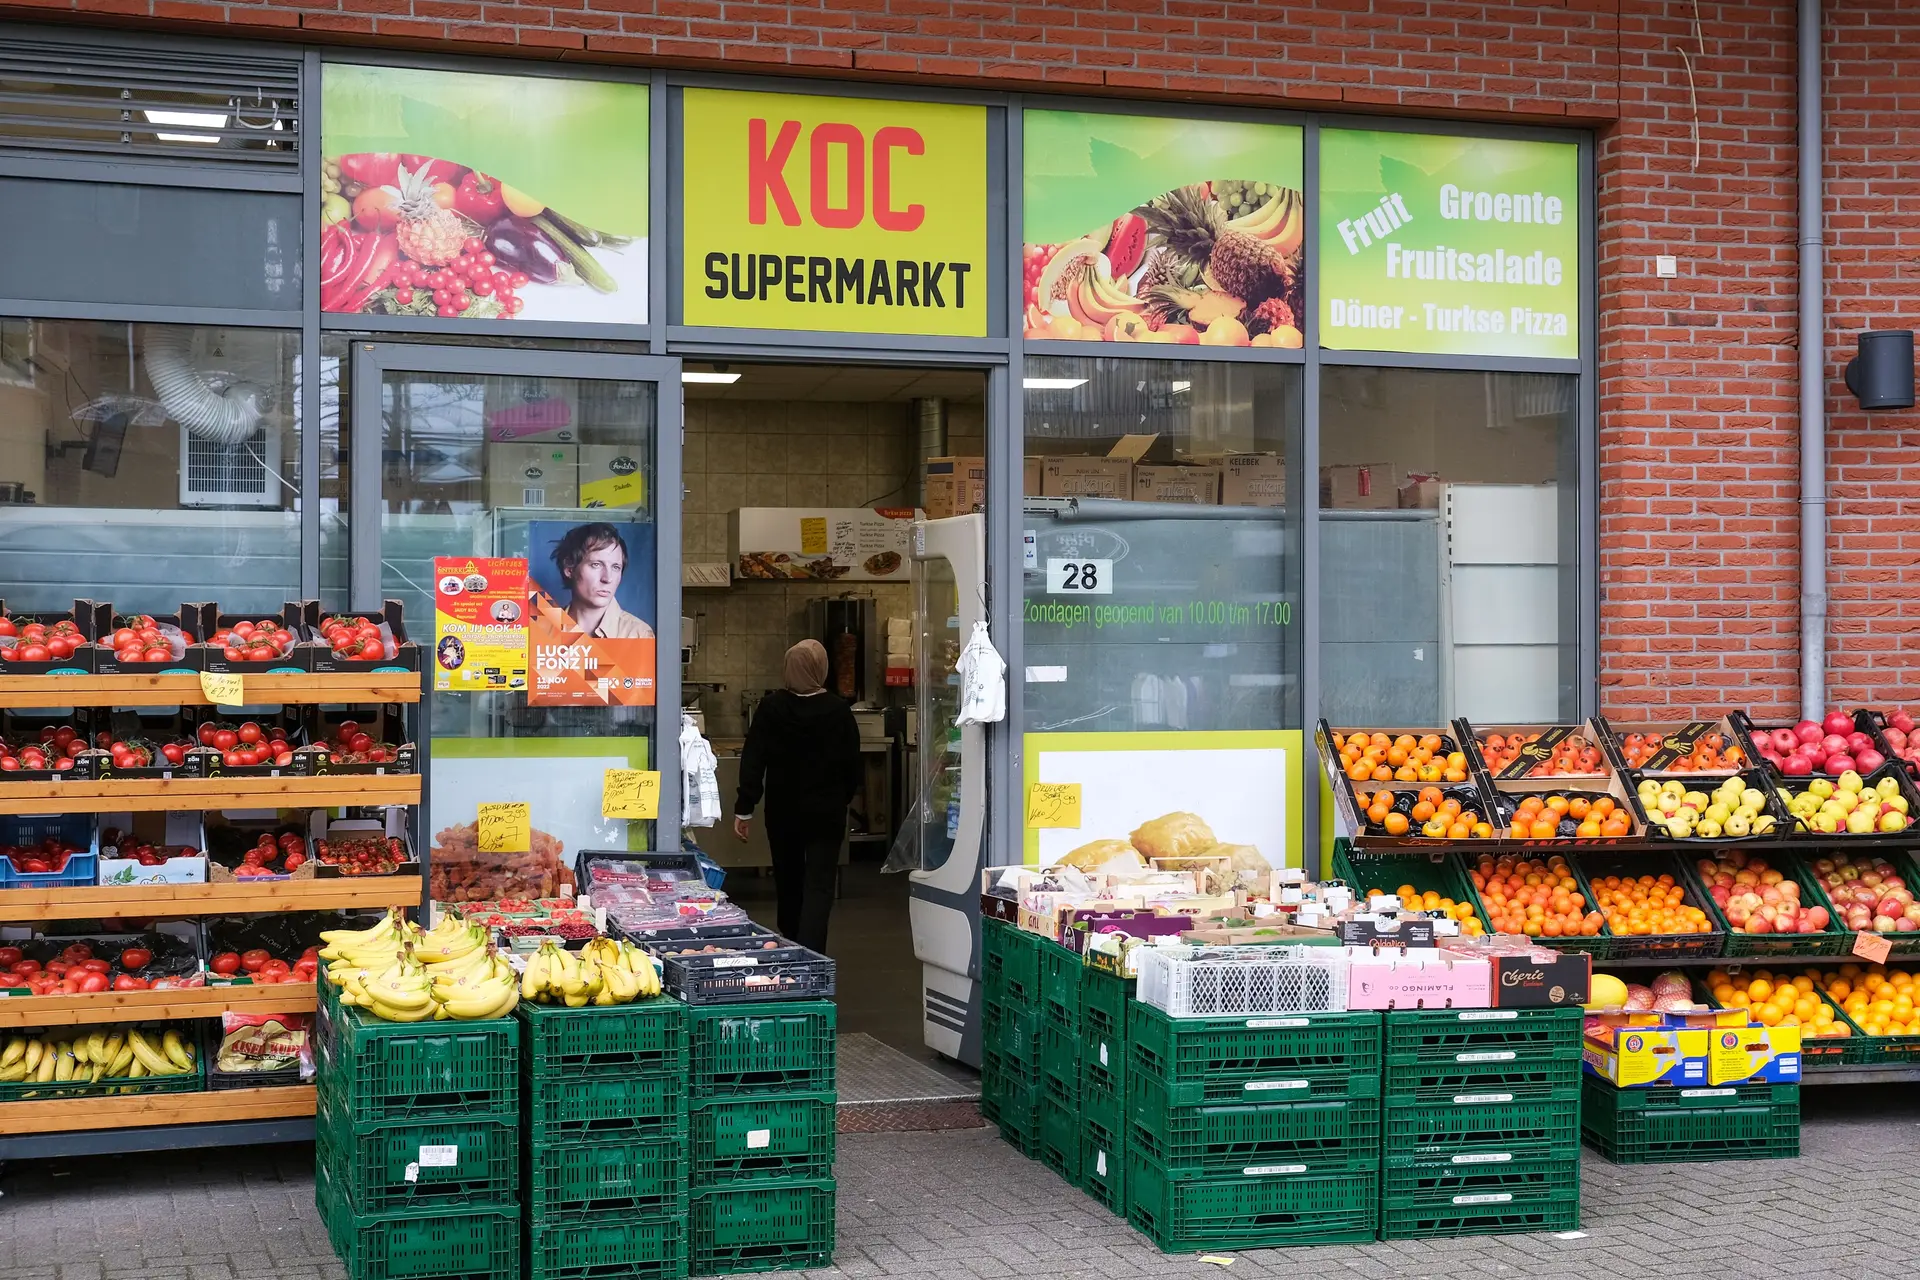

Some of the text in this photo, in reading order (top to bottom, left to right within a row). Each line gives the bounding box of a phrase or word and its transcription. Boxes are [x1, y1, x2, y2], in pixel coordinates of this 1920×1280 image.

[749, 118, 925, 231] KOC
[1440, 184, 1562, 225] Groente
[1336, 192, 1413, 255] Fruit
[1387, 243, 1562, 286] Fruitsalade
[705, 252, 971, 308] SUPERMARKT
[1331, 299, 1403, 329] Döner
[1423, 303, 1505, 334] Turkse
[1511, 307, 1567, 336] Pizza
[1230, 458, 1260, 466] KELEBEK
[1062, 563, 1098, 590] 28
[1023, 600, 1291, 628] Zondagen geopend van 10.00 t/m 17.00
[443, 624, 467, 633] KOM
[470, 624, 483, 633] JIJ
[486, 624, 510, 633] OOK
[536, 645, 592, 657] LUCKY
[536, 658, 598, 670] FONZ III
[1502, 968, 1545, 986] Cherie
